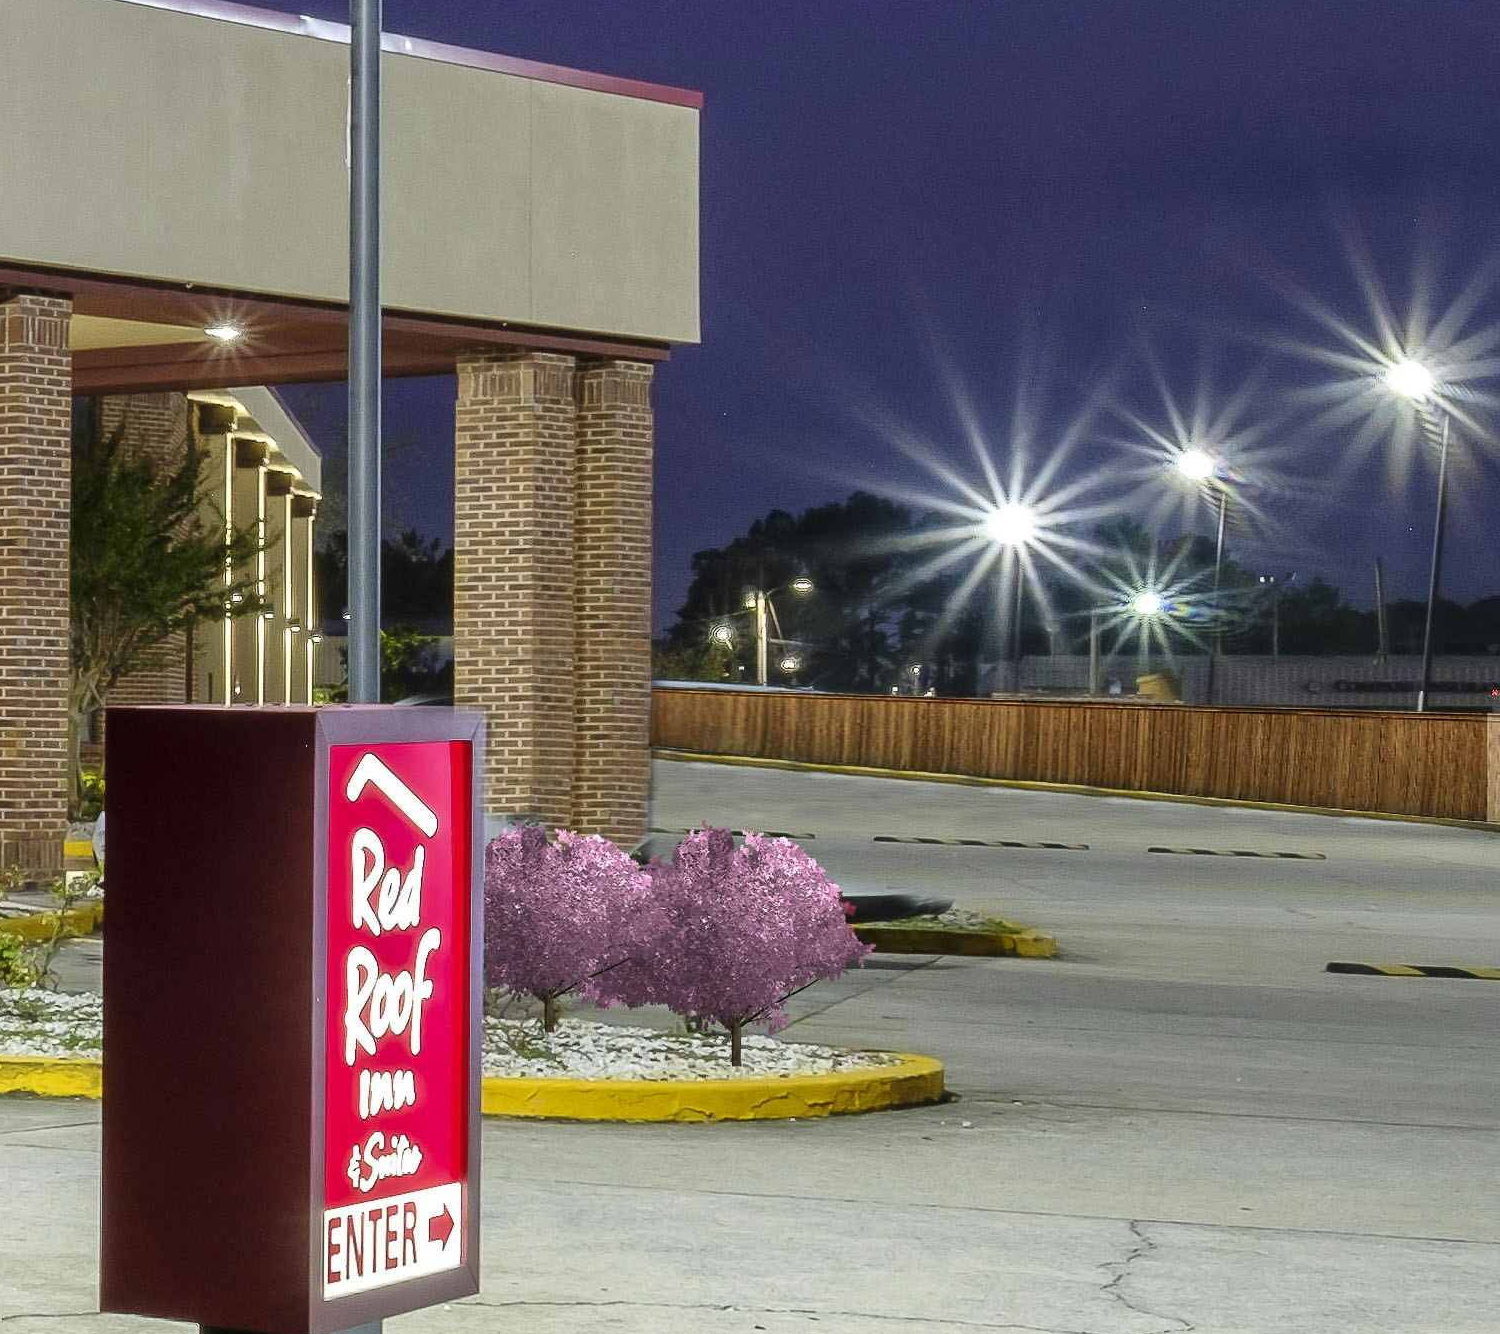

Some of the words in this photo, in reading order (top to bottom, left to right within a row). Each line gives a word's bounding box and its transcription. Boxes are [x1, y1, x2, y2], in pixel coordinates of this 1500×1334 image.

[351, 827, 425, 937] Red
[345, 927, 441, 1066] Roof
[327, 1201, 418, 1285] ENTER
